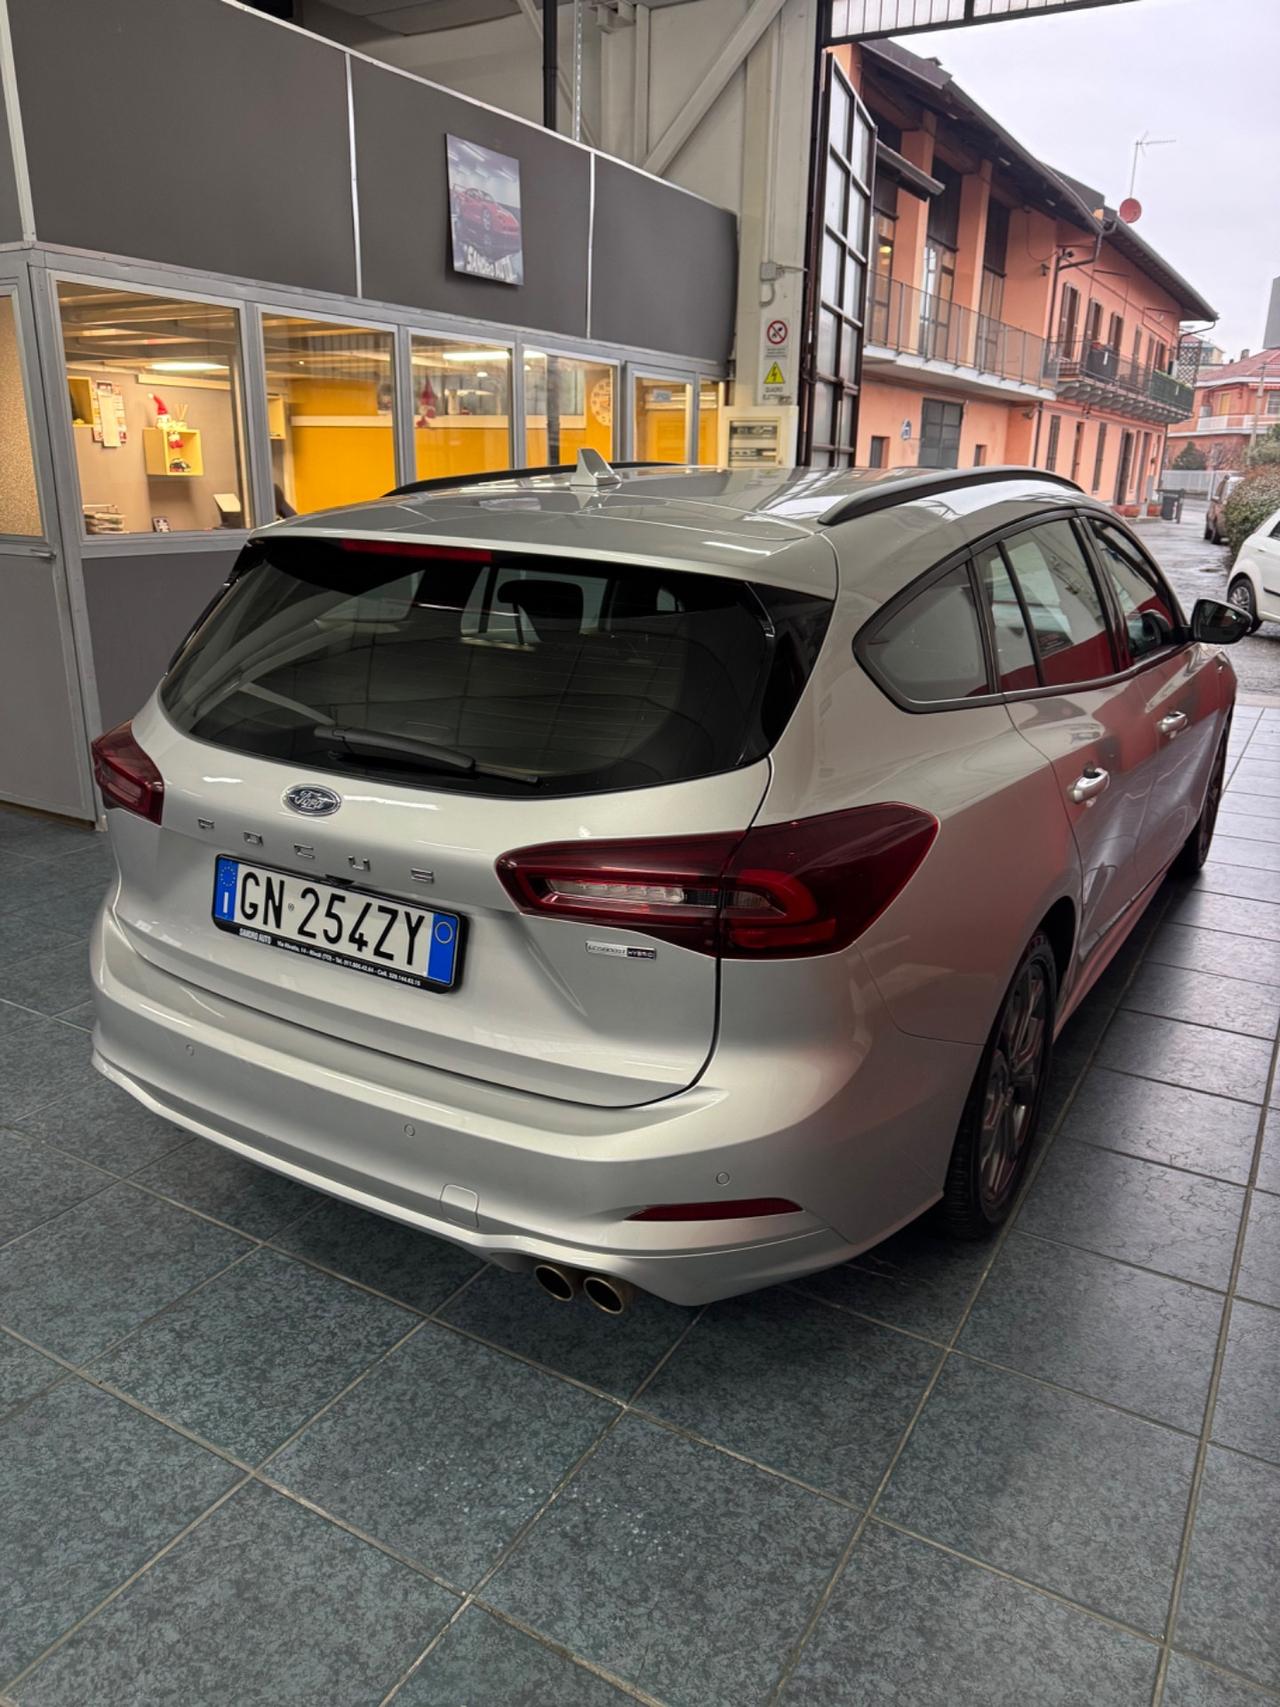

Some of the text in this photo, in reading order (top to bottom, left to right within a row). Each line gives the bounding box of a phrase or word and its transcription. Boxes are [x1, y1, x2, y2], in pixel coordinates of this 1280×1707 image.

[198, 817, 434, 884] FOCUS
[240, 871, 426, 967] GN 254ZY
